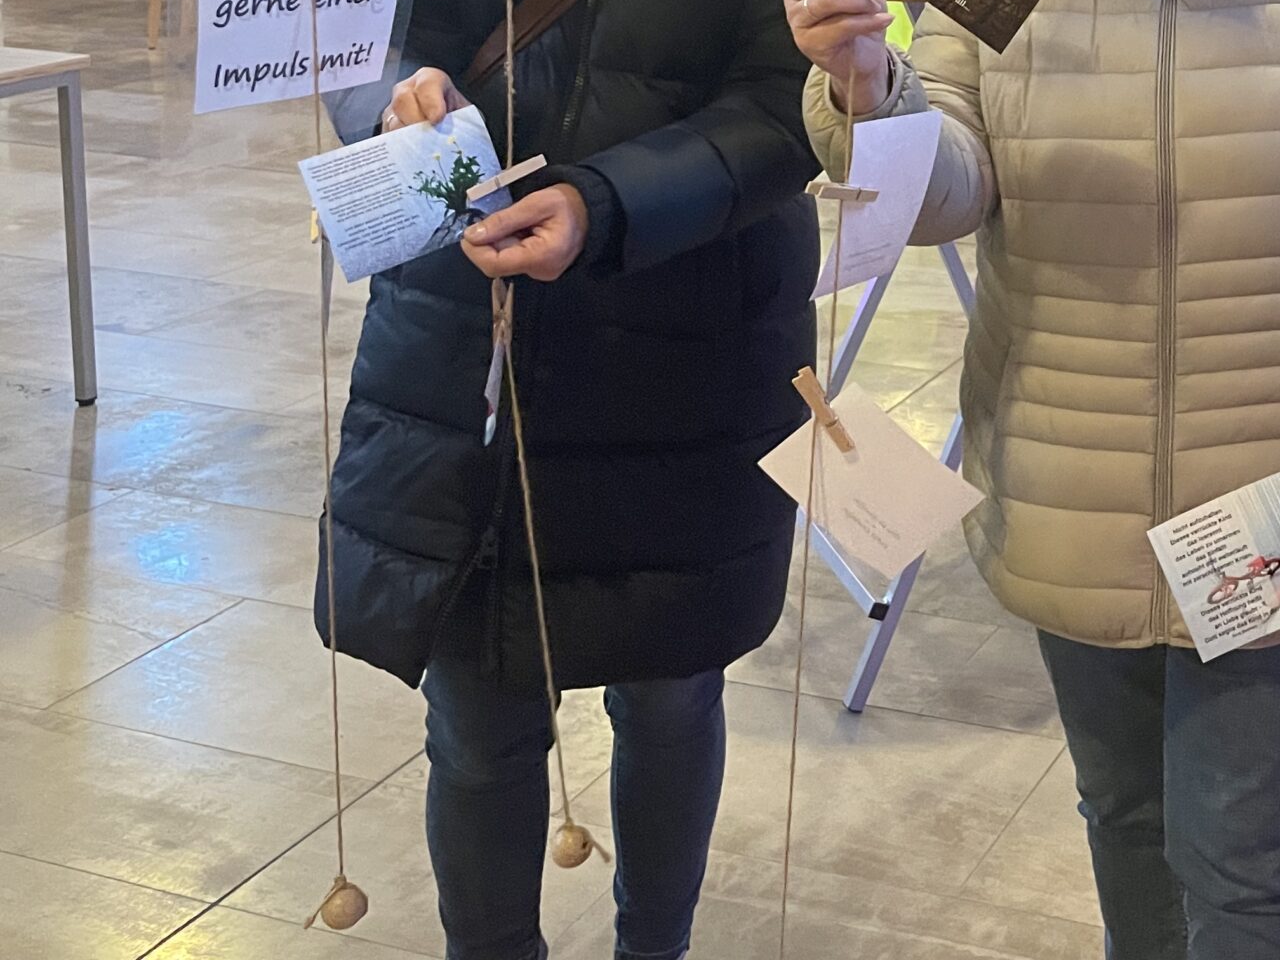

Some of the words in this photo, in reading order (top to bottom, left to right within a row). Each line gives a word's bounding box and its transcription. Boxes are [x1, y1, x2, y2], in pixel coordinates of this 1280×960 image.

[214, 51, 308, 92] Impuls
[319, 41, 374, 71] mit!
[1186, 545, 1205, 557] Leben
